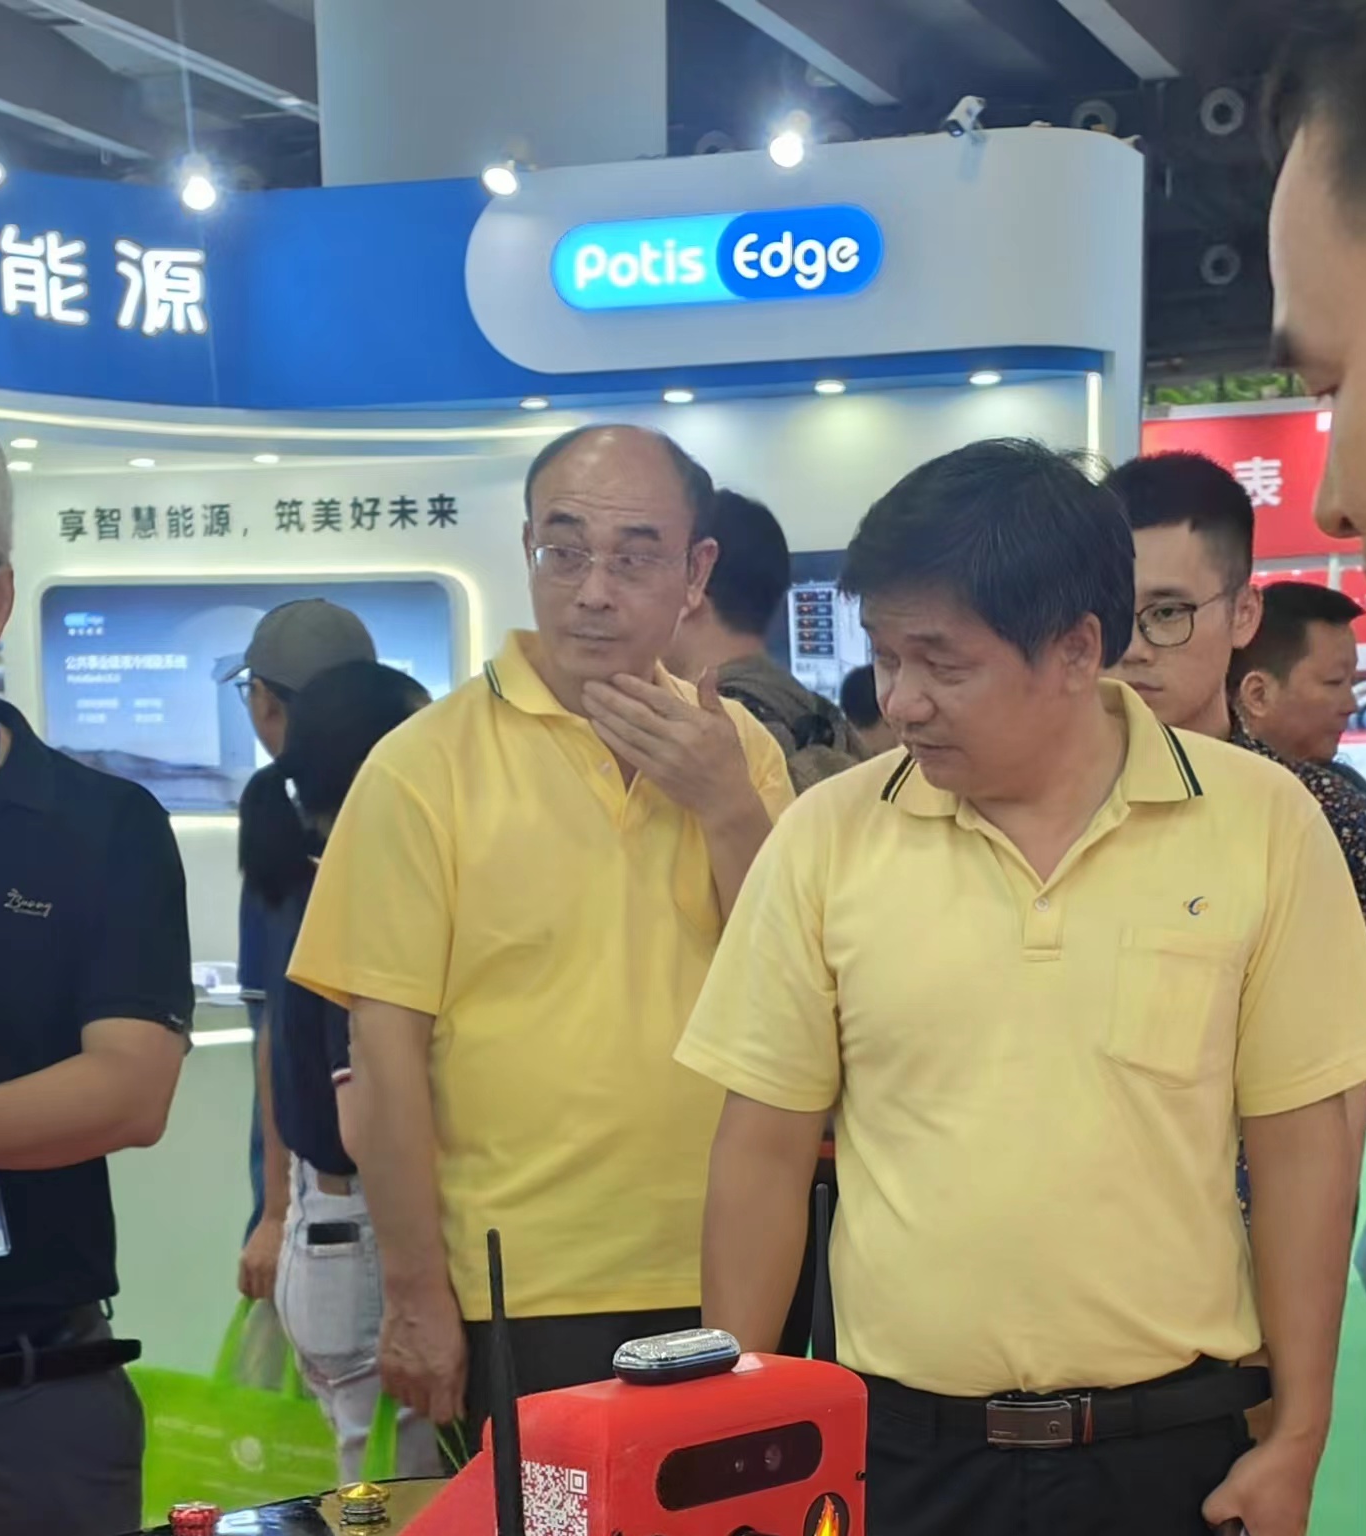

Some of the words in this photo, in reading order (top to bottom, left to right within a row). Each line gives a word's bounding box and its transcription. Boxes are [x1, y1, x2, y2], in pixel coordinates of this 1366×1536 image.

[574, 238, 706, 290] Potis
[733, 230, 860, 290] Edge
[57, 493, 459, 542] 享智慧能源，筑美好未来
